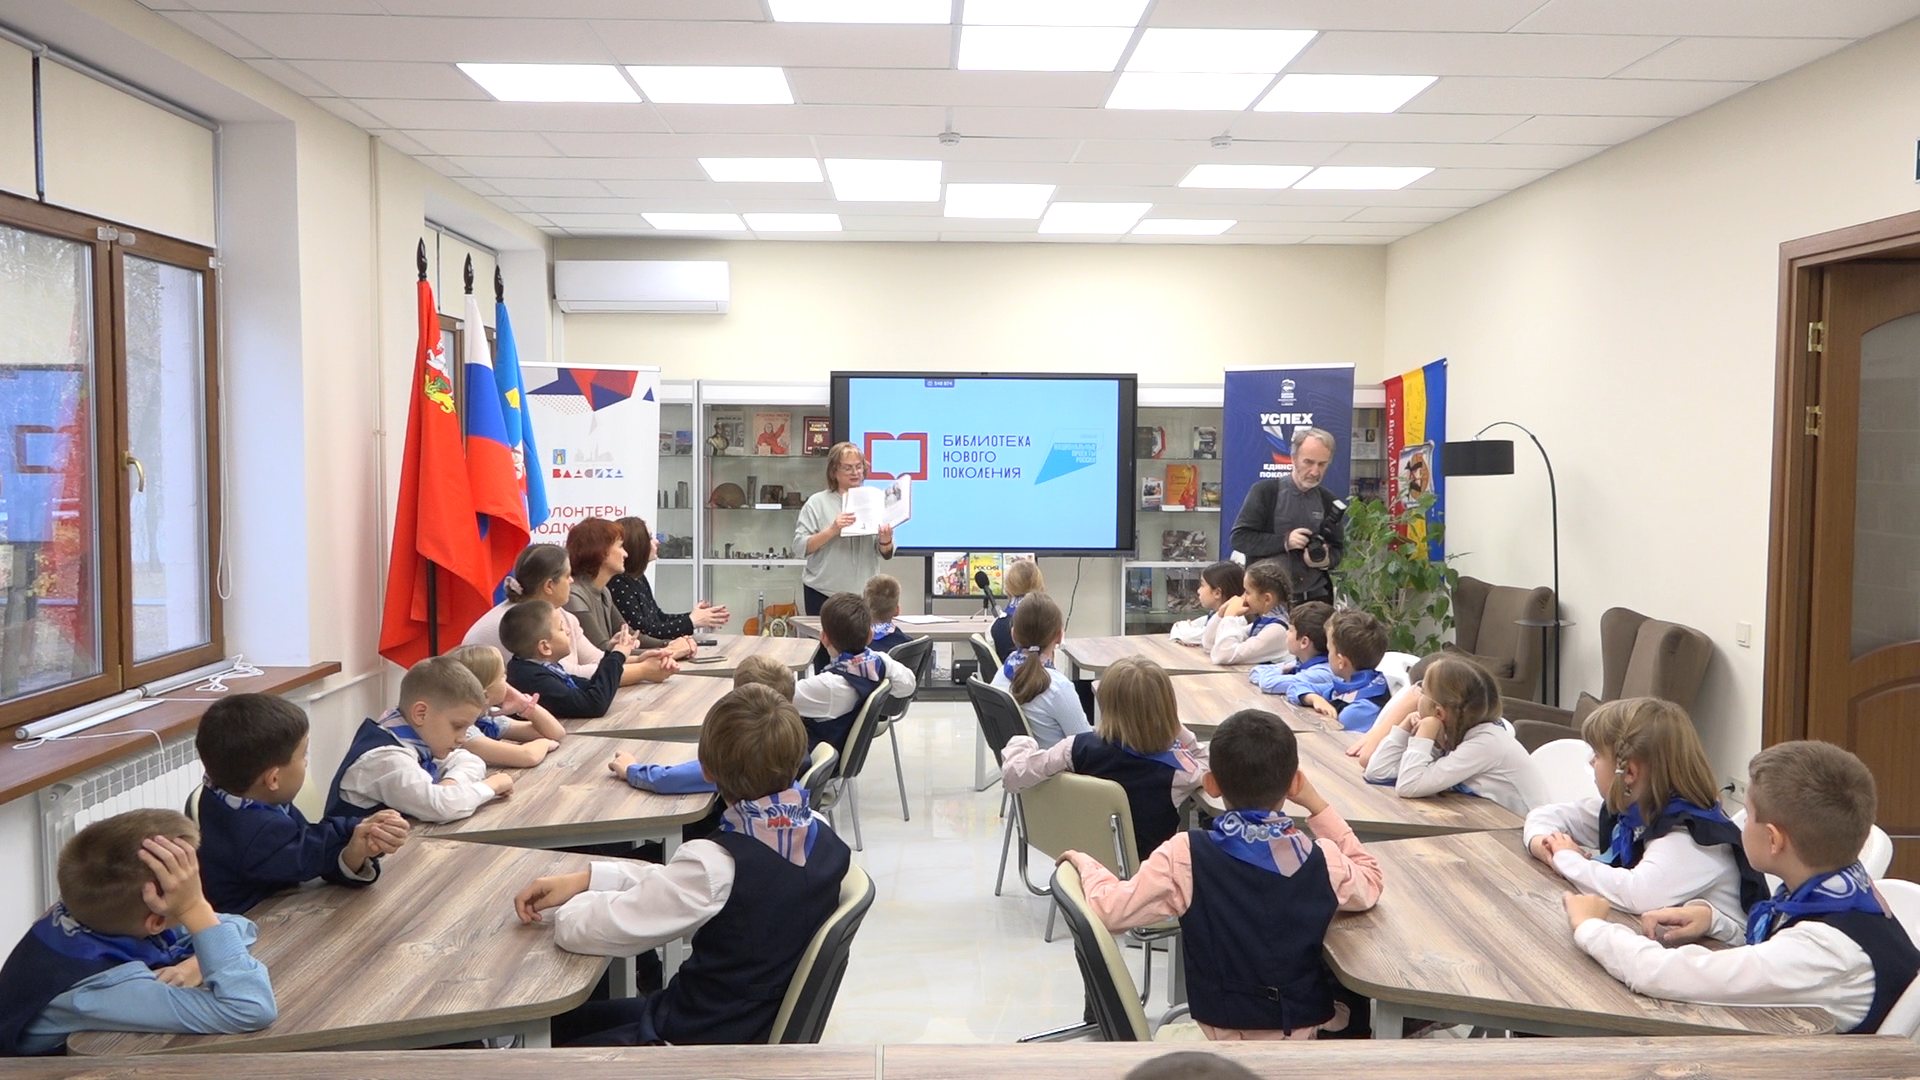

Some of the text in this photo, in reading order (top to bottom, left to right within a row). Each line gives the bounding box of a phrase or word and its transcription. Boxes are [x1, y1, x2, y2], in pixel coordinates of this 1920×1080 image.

[1260, 413, 1313, 425] УСПЕХ
[943, 434, 1031, 447] БИБЛИОТЕКА
[943, 450, 996, 463] НОВОГО
[943, 466, 1021, 479] ПОКОЛЕНИЯ
[548, 505, 627, 518] ЛОНТЕРЫ
